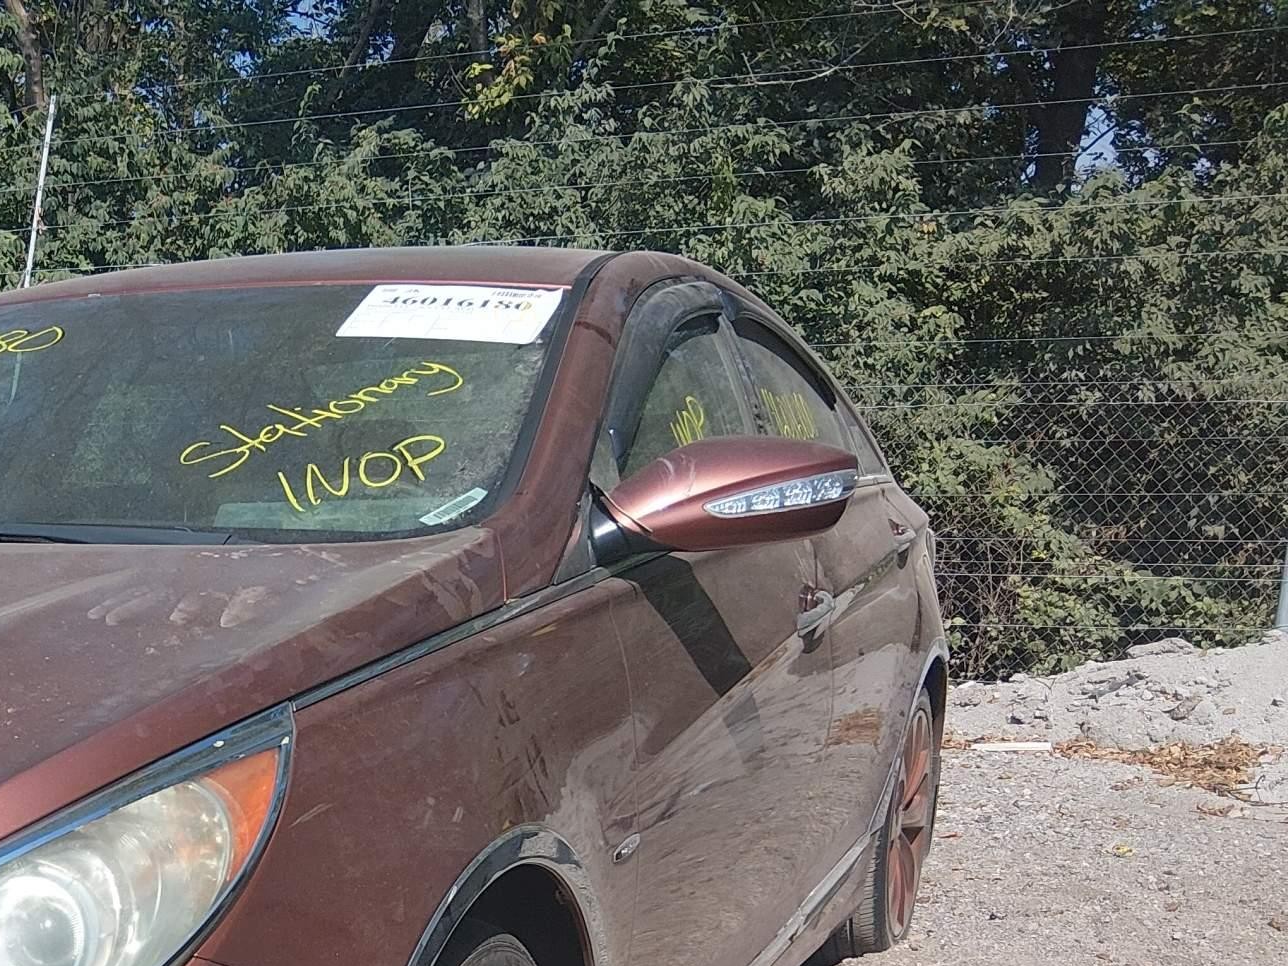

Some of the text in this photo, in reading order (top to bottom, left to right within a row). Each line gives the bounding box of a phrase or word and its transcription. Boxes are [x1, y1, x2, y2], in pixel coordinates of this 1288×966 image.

[383, 295, 533, 312] 46016180
[179, 361, 463, 478] Stationary
[277, 434, 446, 512] INOP
